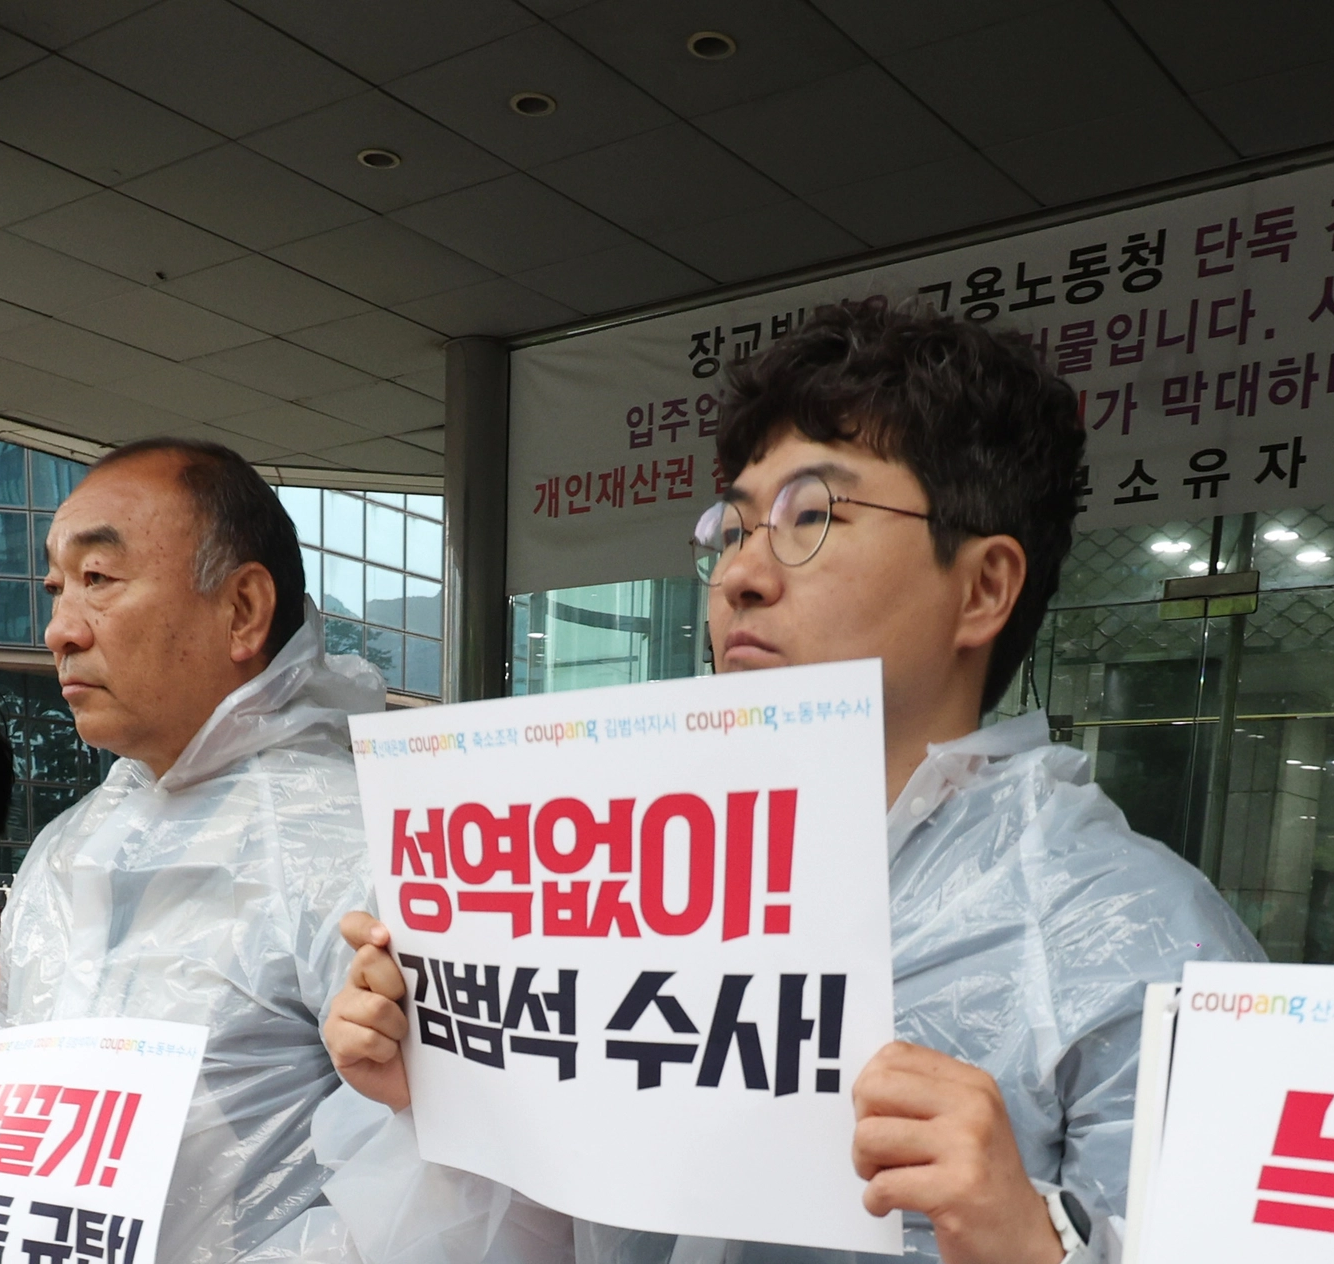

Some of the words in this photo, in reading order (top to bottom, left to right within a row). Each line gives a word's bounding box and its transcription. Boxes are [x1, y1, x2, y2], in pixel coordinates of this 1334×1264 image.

[1194, 206, 1298, 278] 단독
[533, 454, 696, 519] 개인재산권
[408, 731, 467, 757] coupang
[523, 716, 599, 745] coupang
[603, 712, 677, 740] 김범석지시
[686, 702, 779, 734] coupang
[782, 697, 872, 725] 노동부수사
[391, 788, 798, 943] 성역없이!
[397, 952, 579, 1082] 김범석
[604, 970, 848, 1098] 수사!
[1190, 988, 1307, 1024] coupang
[99, 1037, 146, 1057] coupang
